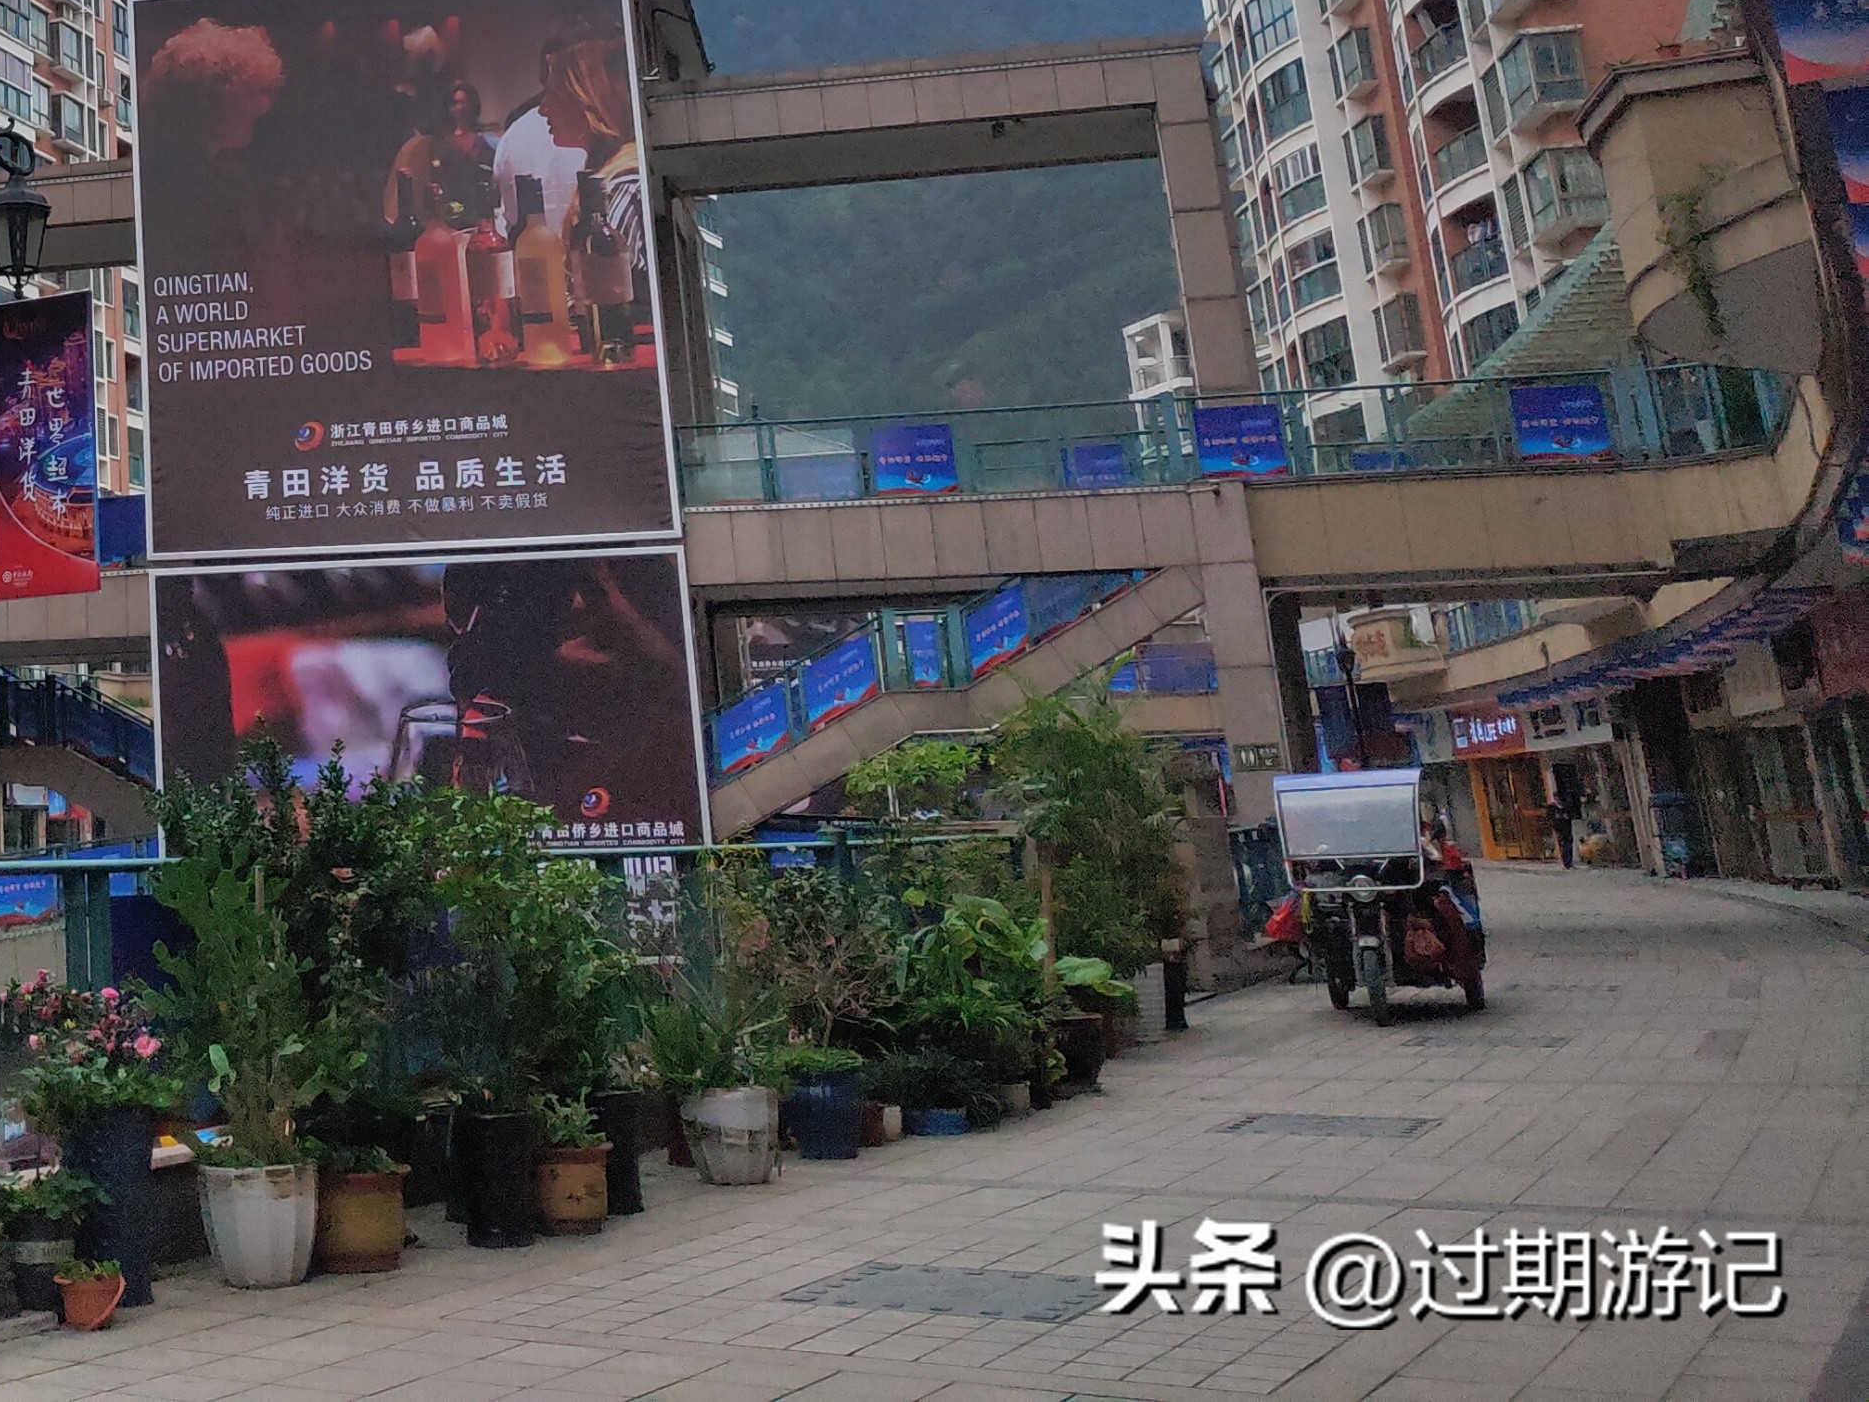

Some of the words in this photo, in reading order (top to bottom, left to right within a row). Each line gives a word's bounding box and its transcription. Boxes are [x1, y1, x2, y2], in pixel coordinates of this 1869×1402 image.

[153, 272, 255, 298] QINGTIAN,
[155, 304, 170, 325] A
[173, 301, 248, 324] WORLD
[156, 325, 306, 354] SUPERMARKET
[158, 361, 184, 382] OF
[189, 355, 294, 381] IMPORTED
[300, 350, 372, 375] GOODS
[16, 368, 38, 502] 青田洋货
[330, 414, 509, 439] 浙江青田侨乡进口商品城
[46, 386, 68, 521] 世界超市
[243, 461, 391, 501] 青田洋货
[415, 453, 568, 492] 品质生活
[265, 503, 330, 521] 纯正进口
[336, 499, 402, 519] 大众消费
[408, 495, 475, 515] 不做暴利
[481, 491, 549, 511] 不卖假货
